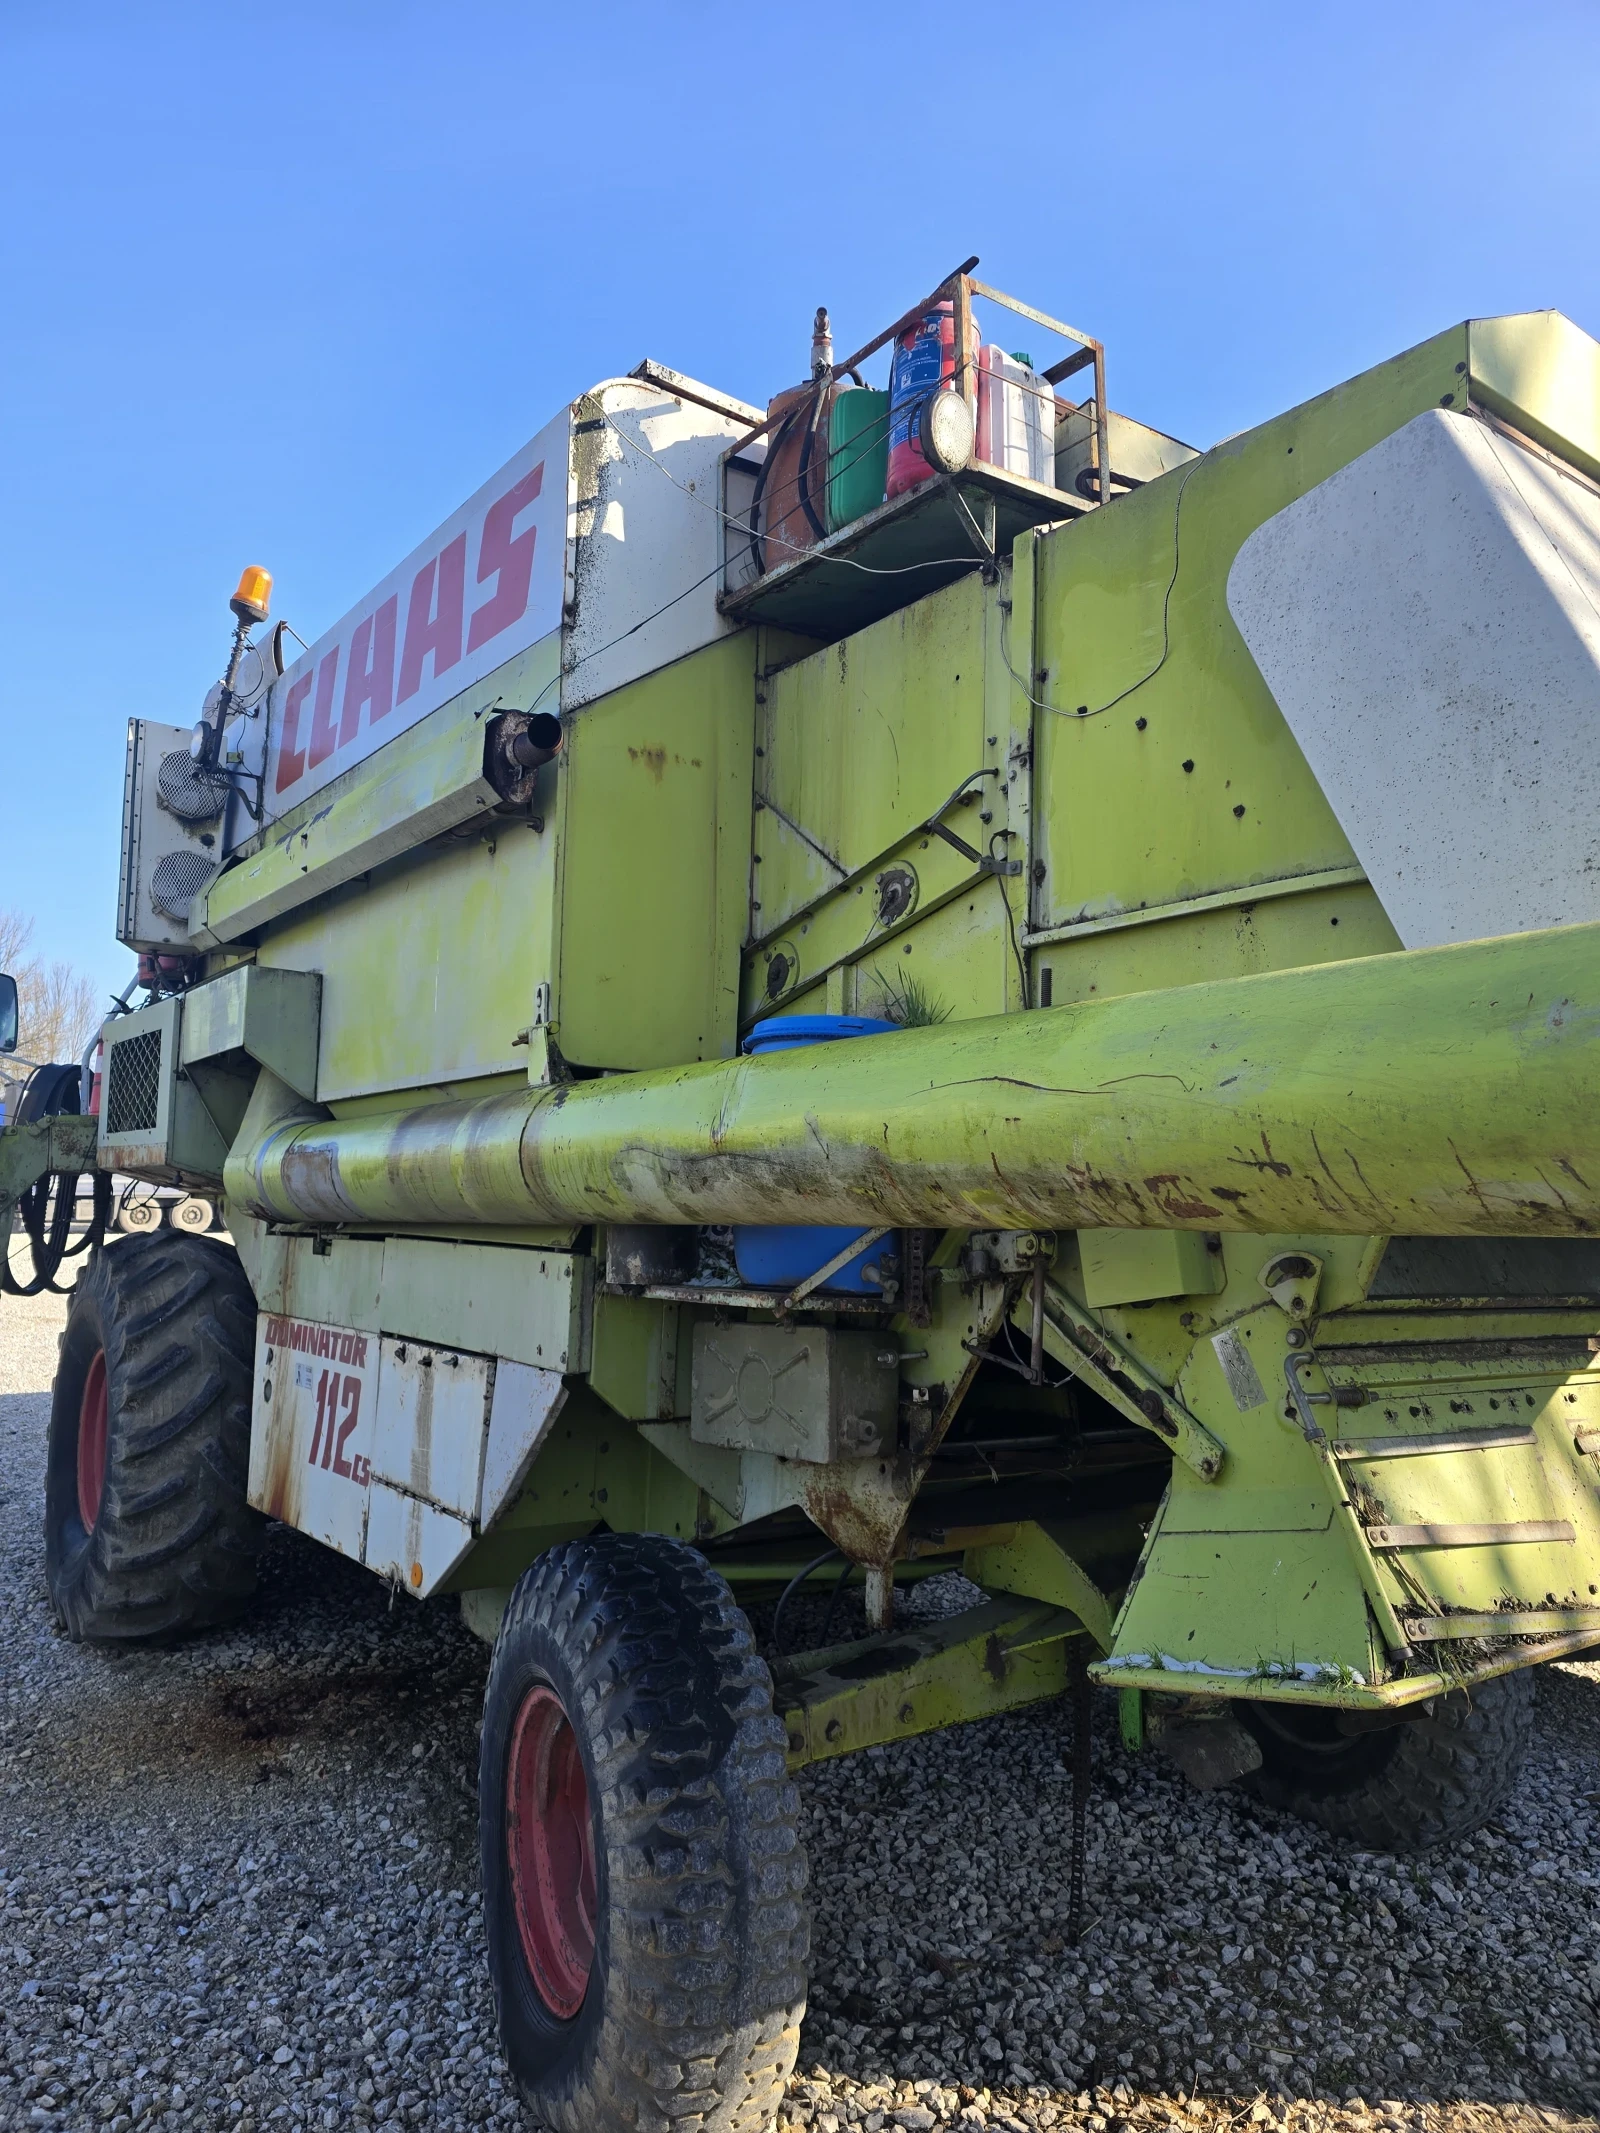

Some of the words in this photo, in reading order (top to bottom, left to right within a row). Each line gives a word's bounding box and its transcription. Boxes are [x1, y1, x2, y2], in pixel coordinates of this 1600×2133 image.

[276, 459, 545, 795] CLAAS
[264, 1318, 369, 1370] DOMINATOR
[308, 1368, 362, 1479] 112
